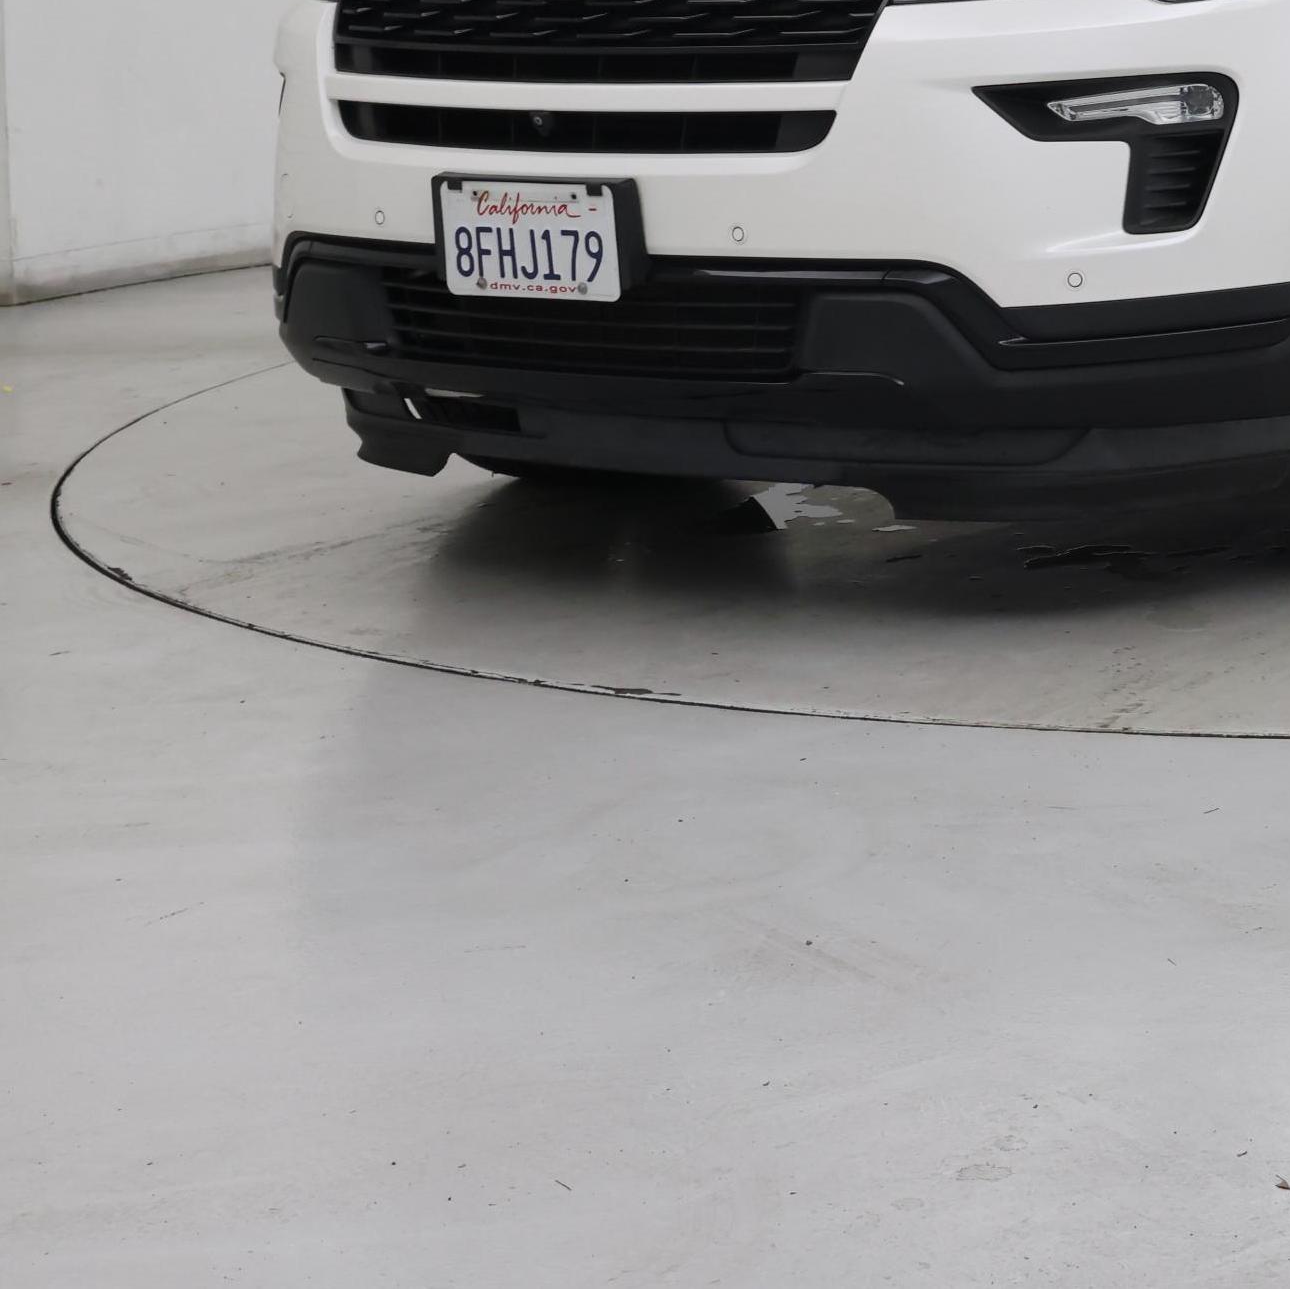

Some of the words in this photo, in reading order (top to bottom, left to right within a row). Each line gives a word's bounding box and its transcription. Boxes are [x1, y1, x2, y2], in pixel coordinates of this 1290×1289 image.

[476, 190, 581, 224] California
[455, 226, 604, 283] 8FHJ179
[489, 281, 577, 294] dmv.ca.gov
